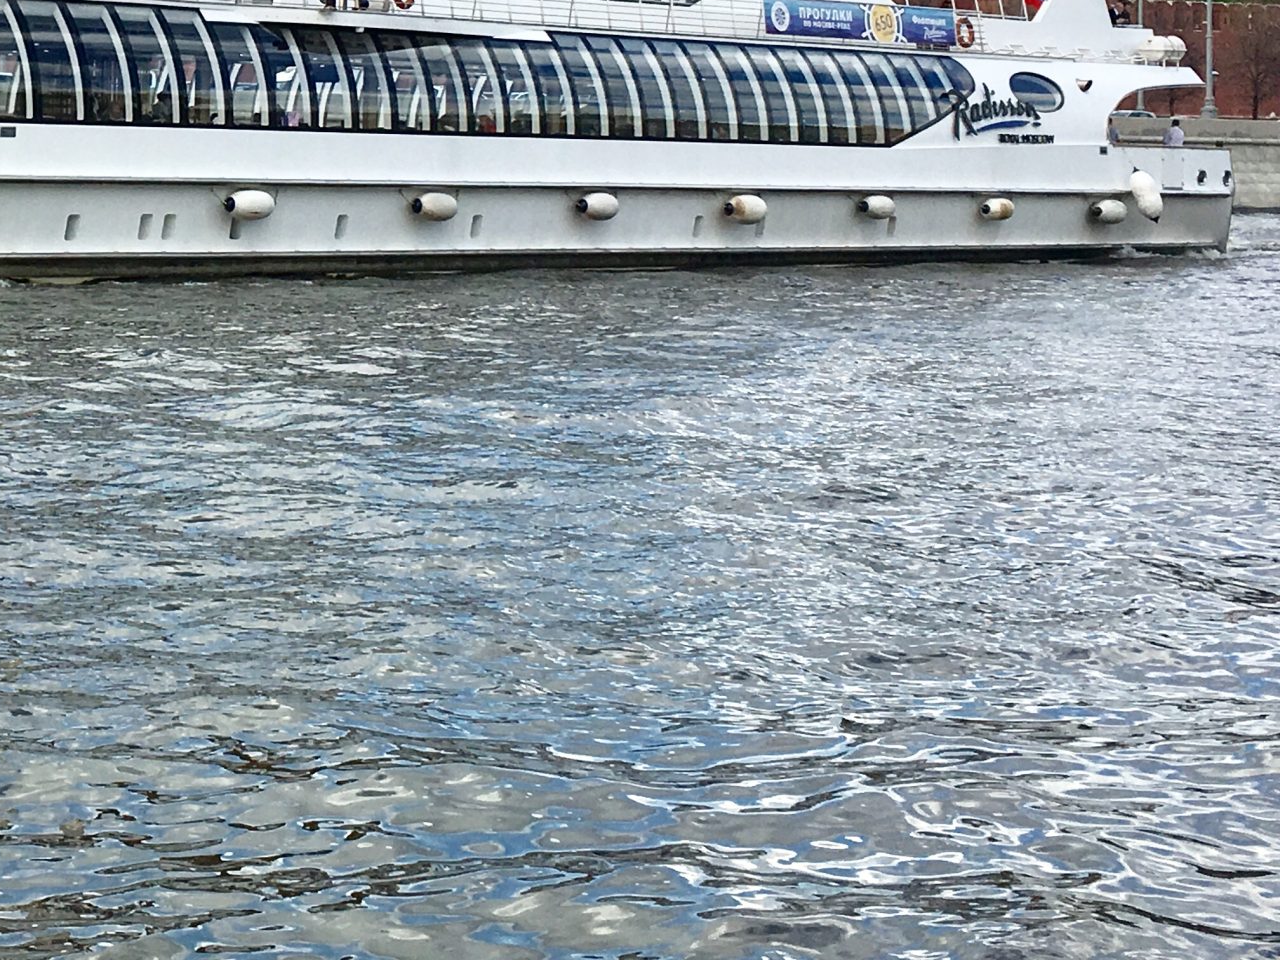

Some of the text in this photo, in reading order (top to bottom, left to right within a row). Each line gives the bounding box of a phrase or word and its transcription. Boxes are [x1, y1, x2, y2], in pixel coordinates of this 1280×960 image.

[799, 6, 853, 22] ПРОГУЛКИ
[875, 13, 893, 32] 650
[941, 82, 1041, 141] Radisson
